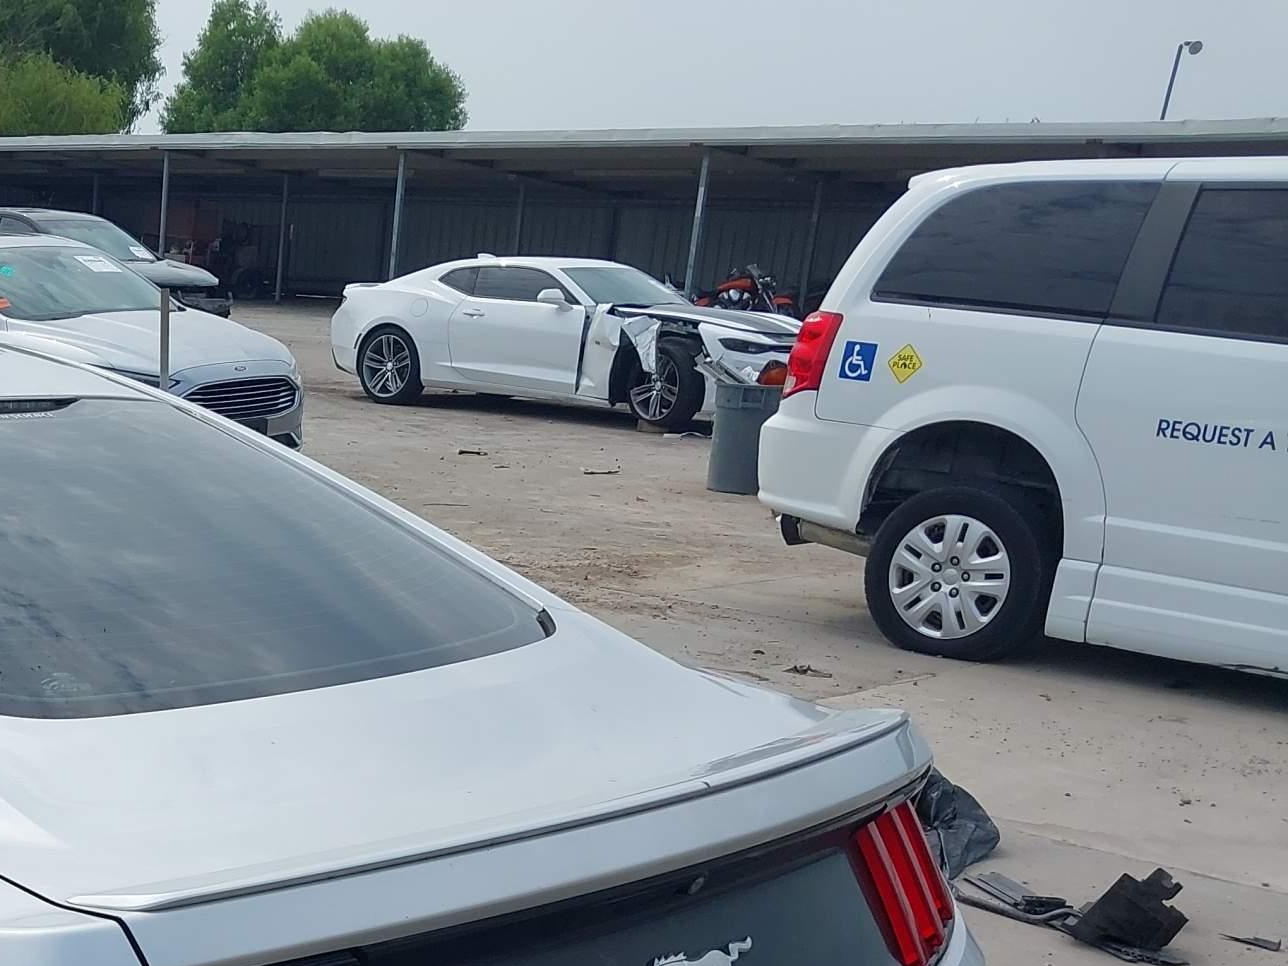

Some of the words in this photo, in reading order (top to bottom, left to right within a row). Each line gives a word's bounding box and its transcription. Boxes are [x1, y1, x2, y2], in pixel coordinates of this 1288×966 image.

[897, 354, 914, 362] SAFE
[1156, 418, 1255, 447] REQUEST
[1258, 431, 1276, 451] A
